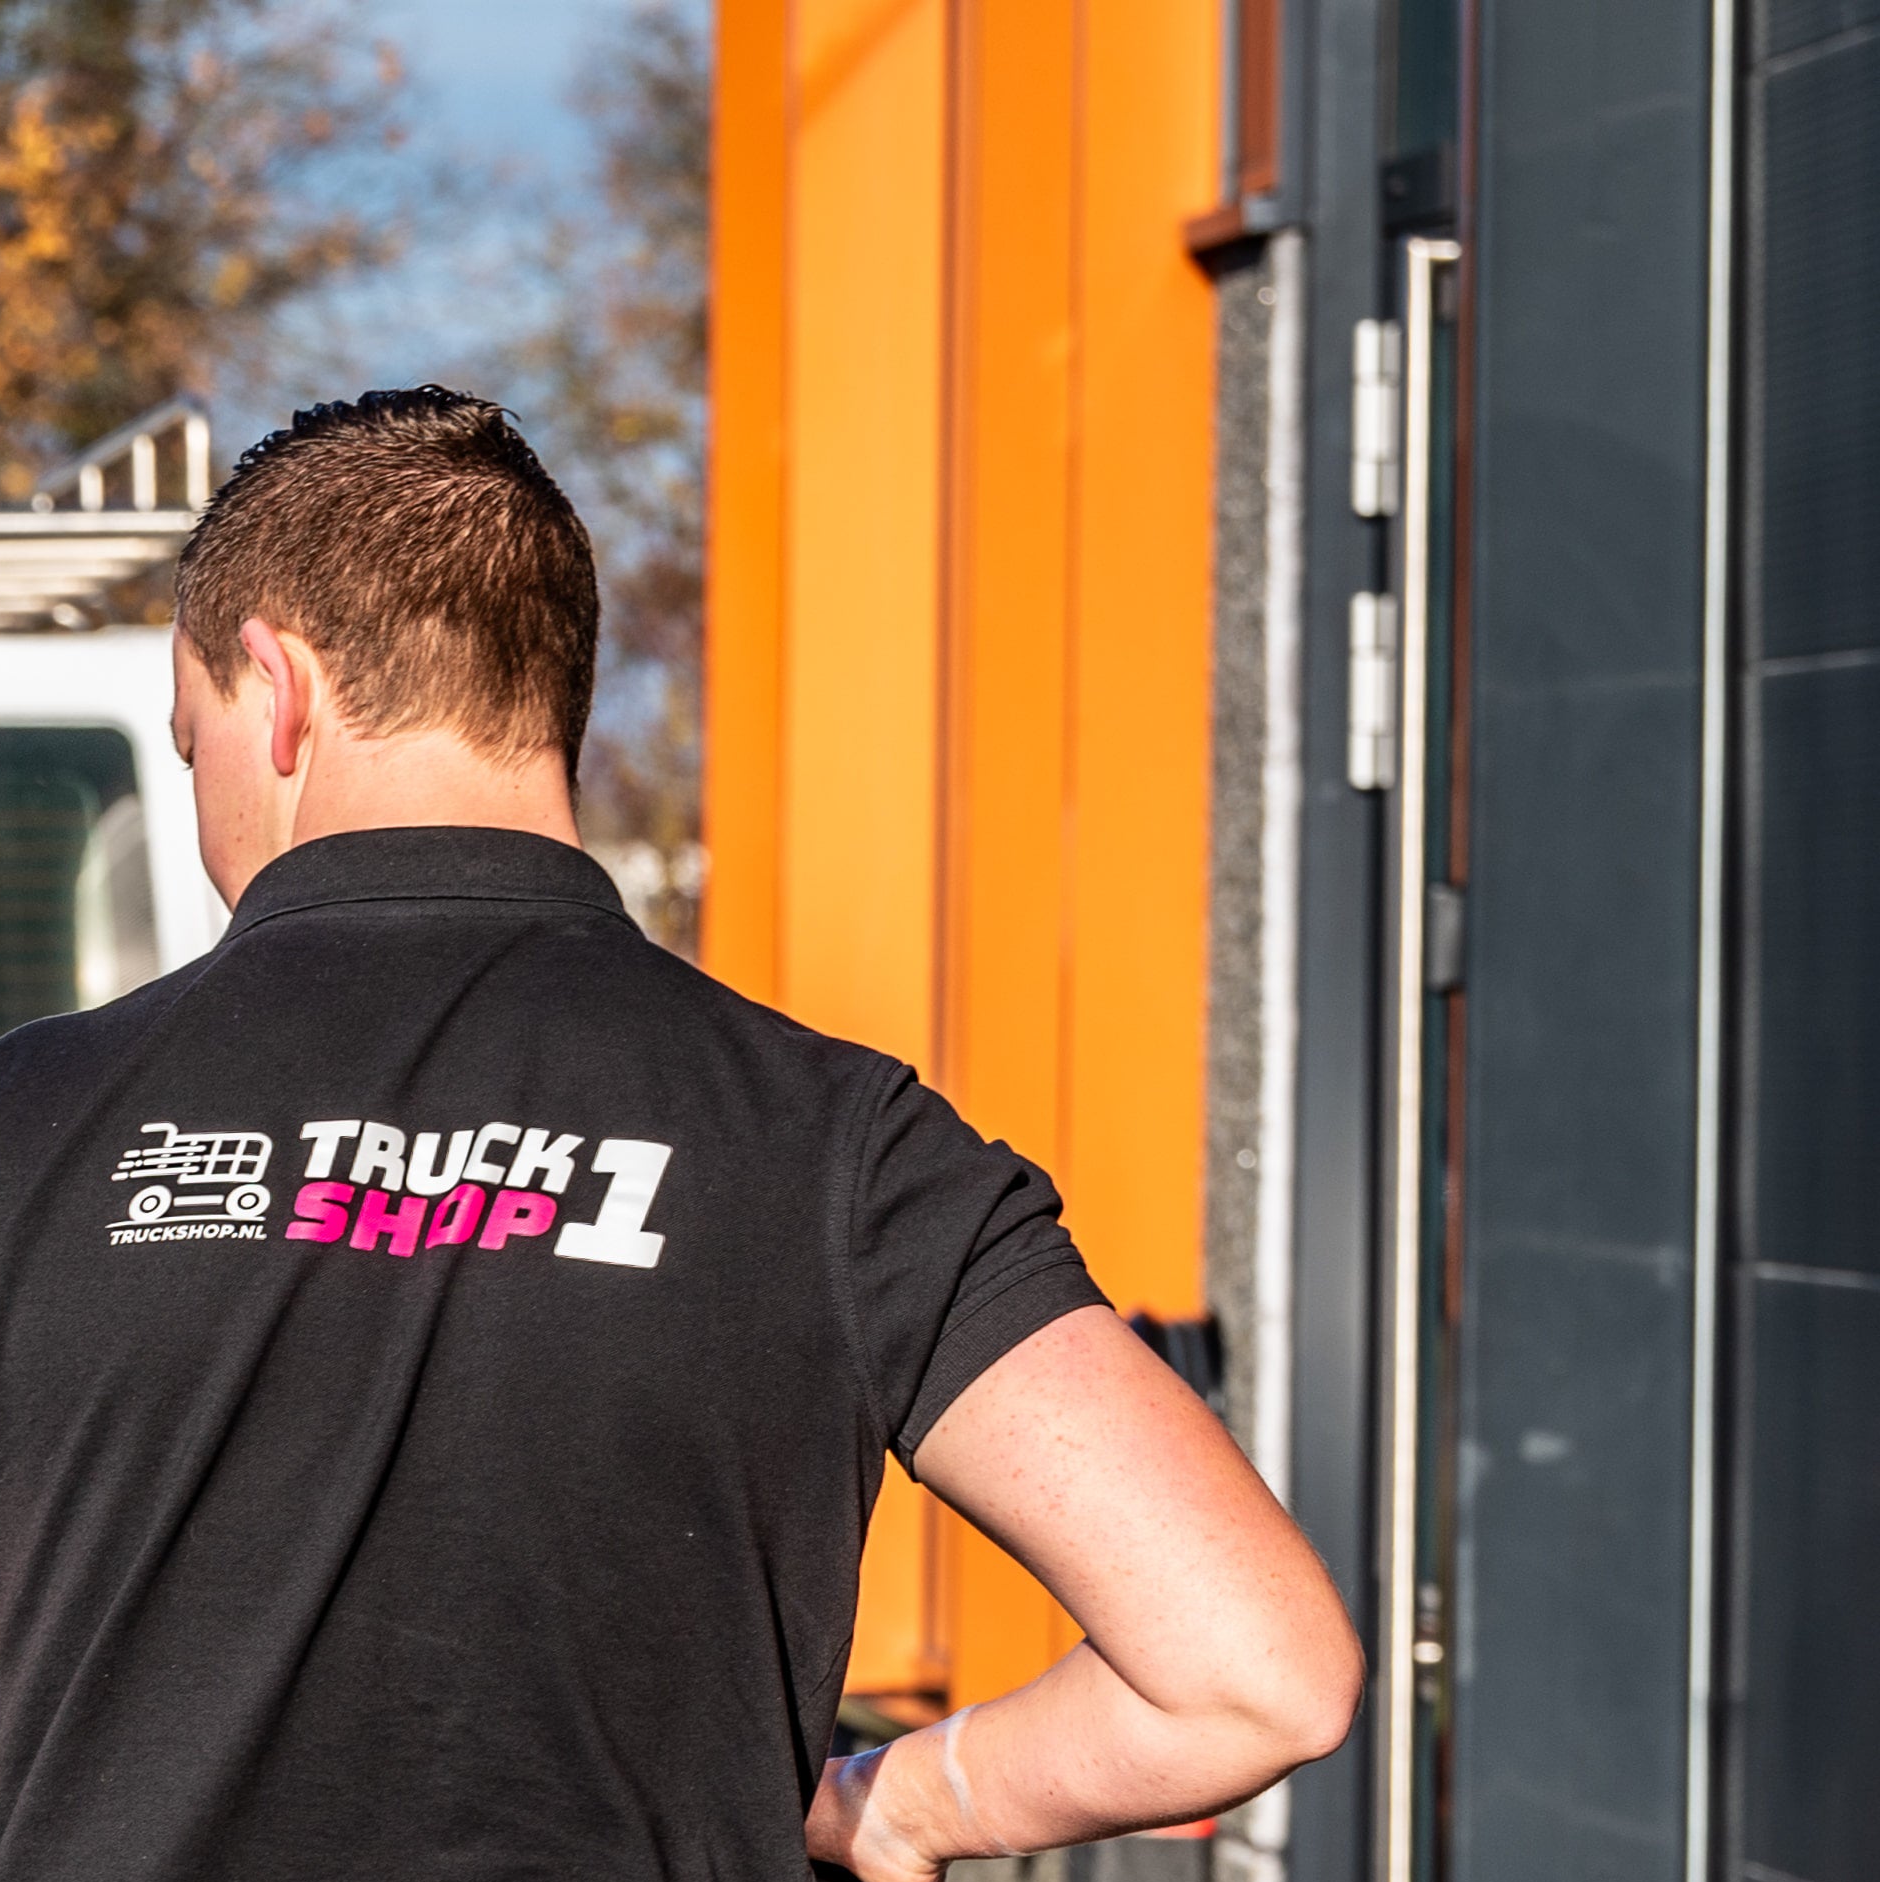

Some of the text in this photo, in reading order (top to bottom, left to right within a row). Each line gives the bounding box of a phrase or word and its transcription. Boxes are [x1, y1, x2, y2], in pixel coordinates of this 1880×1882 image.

[300, 1121, 584, 1195] TRUCK
[110, 1223, 268, 1246] TRUCKSHOP.NL
[285, 1139, 673, 1268] SHOP 1
